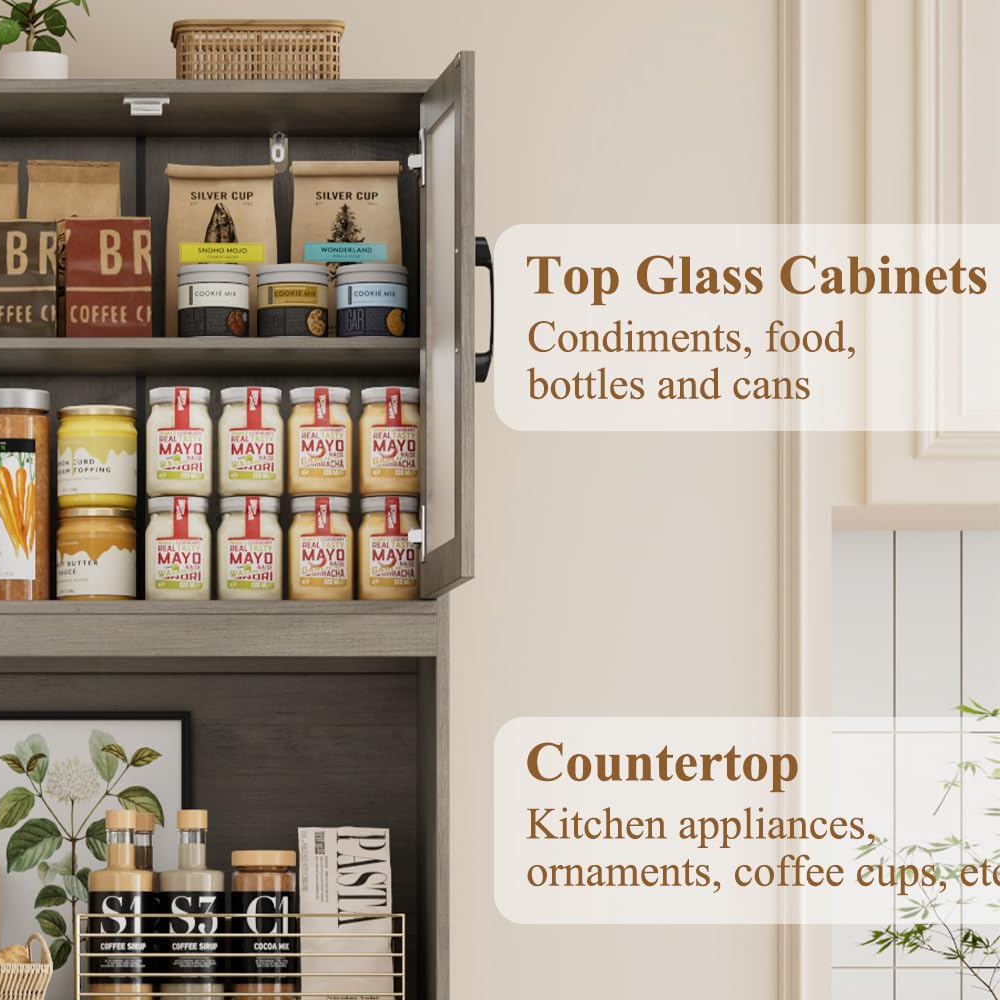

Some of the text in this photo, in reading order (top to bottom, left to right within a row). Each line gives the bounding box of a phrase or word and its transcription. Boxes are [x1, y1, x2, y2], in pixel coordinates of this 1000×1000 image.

[190, 191, 254, 200] SILVER CUP
[315, 191, 378, 200] SILVER CUP
[320, 246, 373, 254] WONDERLAND
[274, 290, 317, 298] COOKIE MIX
[70, 305, 127, 324] COFFEE
[159, 443, 202, 456] MAYO
[231, 443, 274, 456] MAYO
[302, 440, 344, 452] MAYO
[373, 440, 416, 452] MAYO
[158, 552, 201, 564] MAYO
[230, 552, 273, 564] MAYO
[302, 548, 345, 561] MAYO
[372, 548, 415, 561] MAYO
[336, 830, 387, 929] PASTA
[100, 895, 142, 935] S1
[168, 895, 218, 935] S3
[246, 895, 289, 935] C1
[100, 942, 147, 950] COFFEE SIRUP
[172, 942, 218, 950] COFFEE SIRUP
[254, 942, 290, 950] COCOA MIX
